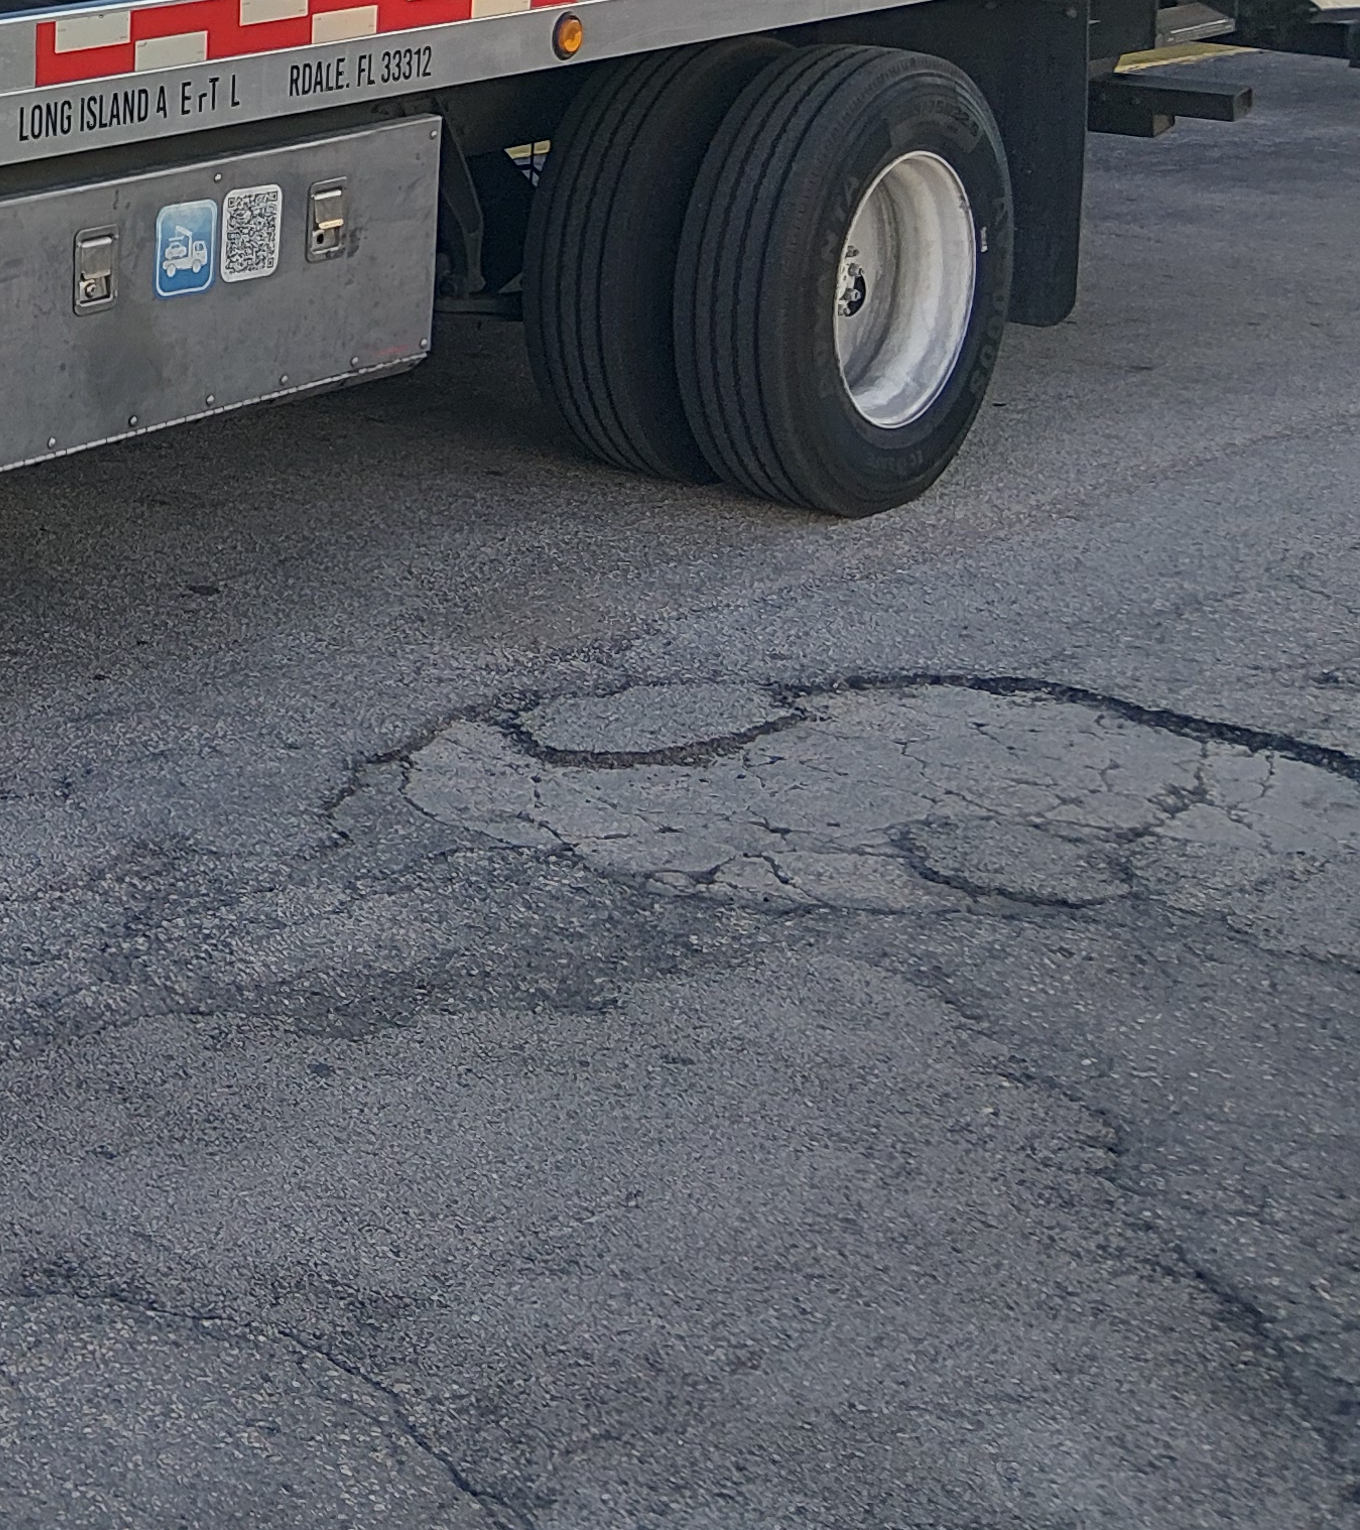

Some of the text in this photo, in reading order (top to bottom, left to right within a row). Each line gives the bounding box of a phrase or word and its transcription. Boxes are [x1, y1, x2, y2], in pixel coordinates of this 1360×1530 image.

[19, 99, 73, 142] LONG
[79, 88, 148, 132] ISLAND
[356, 53, 376, 87] FL
[381, 45, 432, 83] 33312
